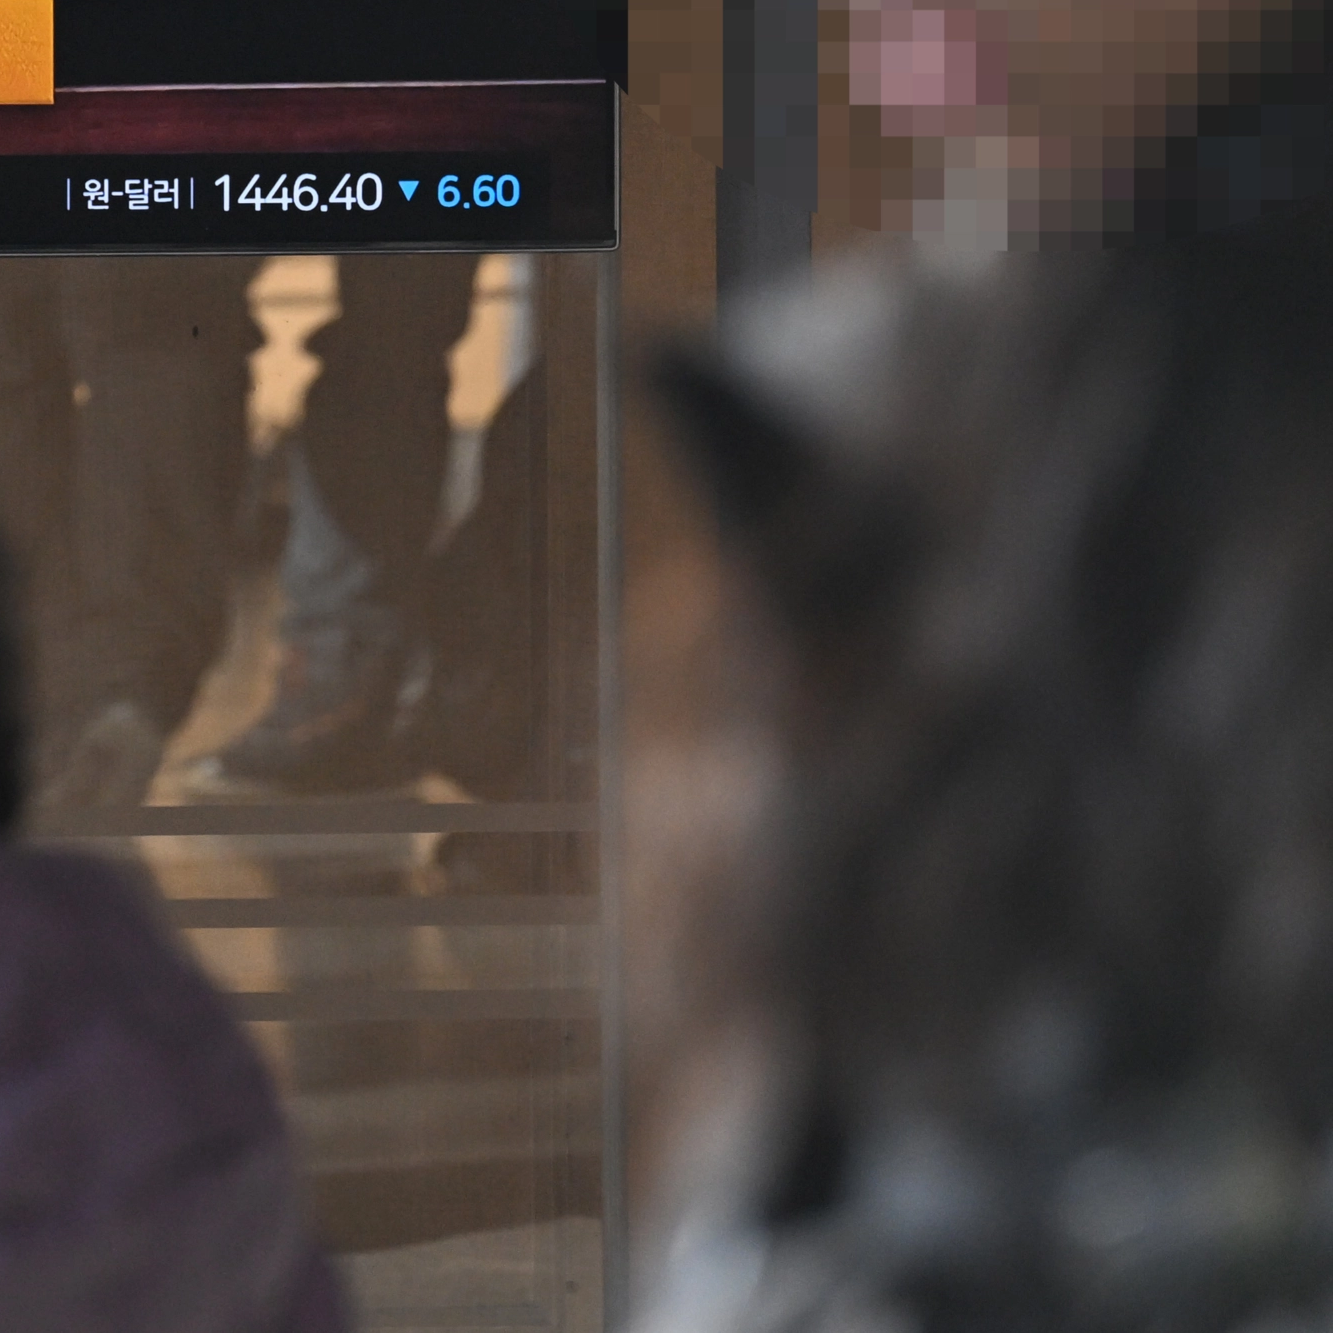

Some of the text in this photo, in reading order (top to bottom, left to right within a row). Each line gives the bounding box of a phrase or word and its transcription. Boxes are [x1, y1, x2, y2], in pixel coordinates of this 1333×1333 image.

[83, 172, 520, 212] 원-달러 1446.40 6.60
